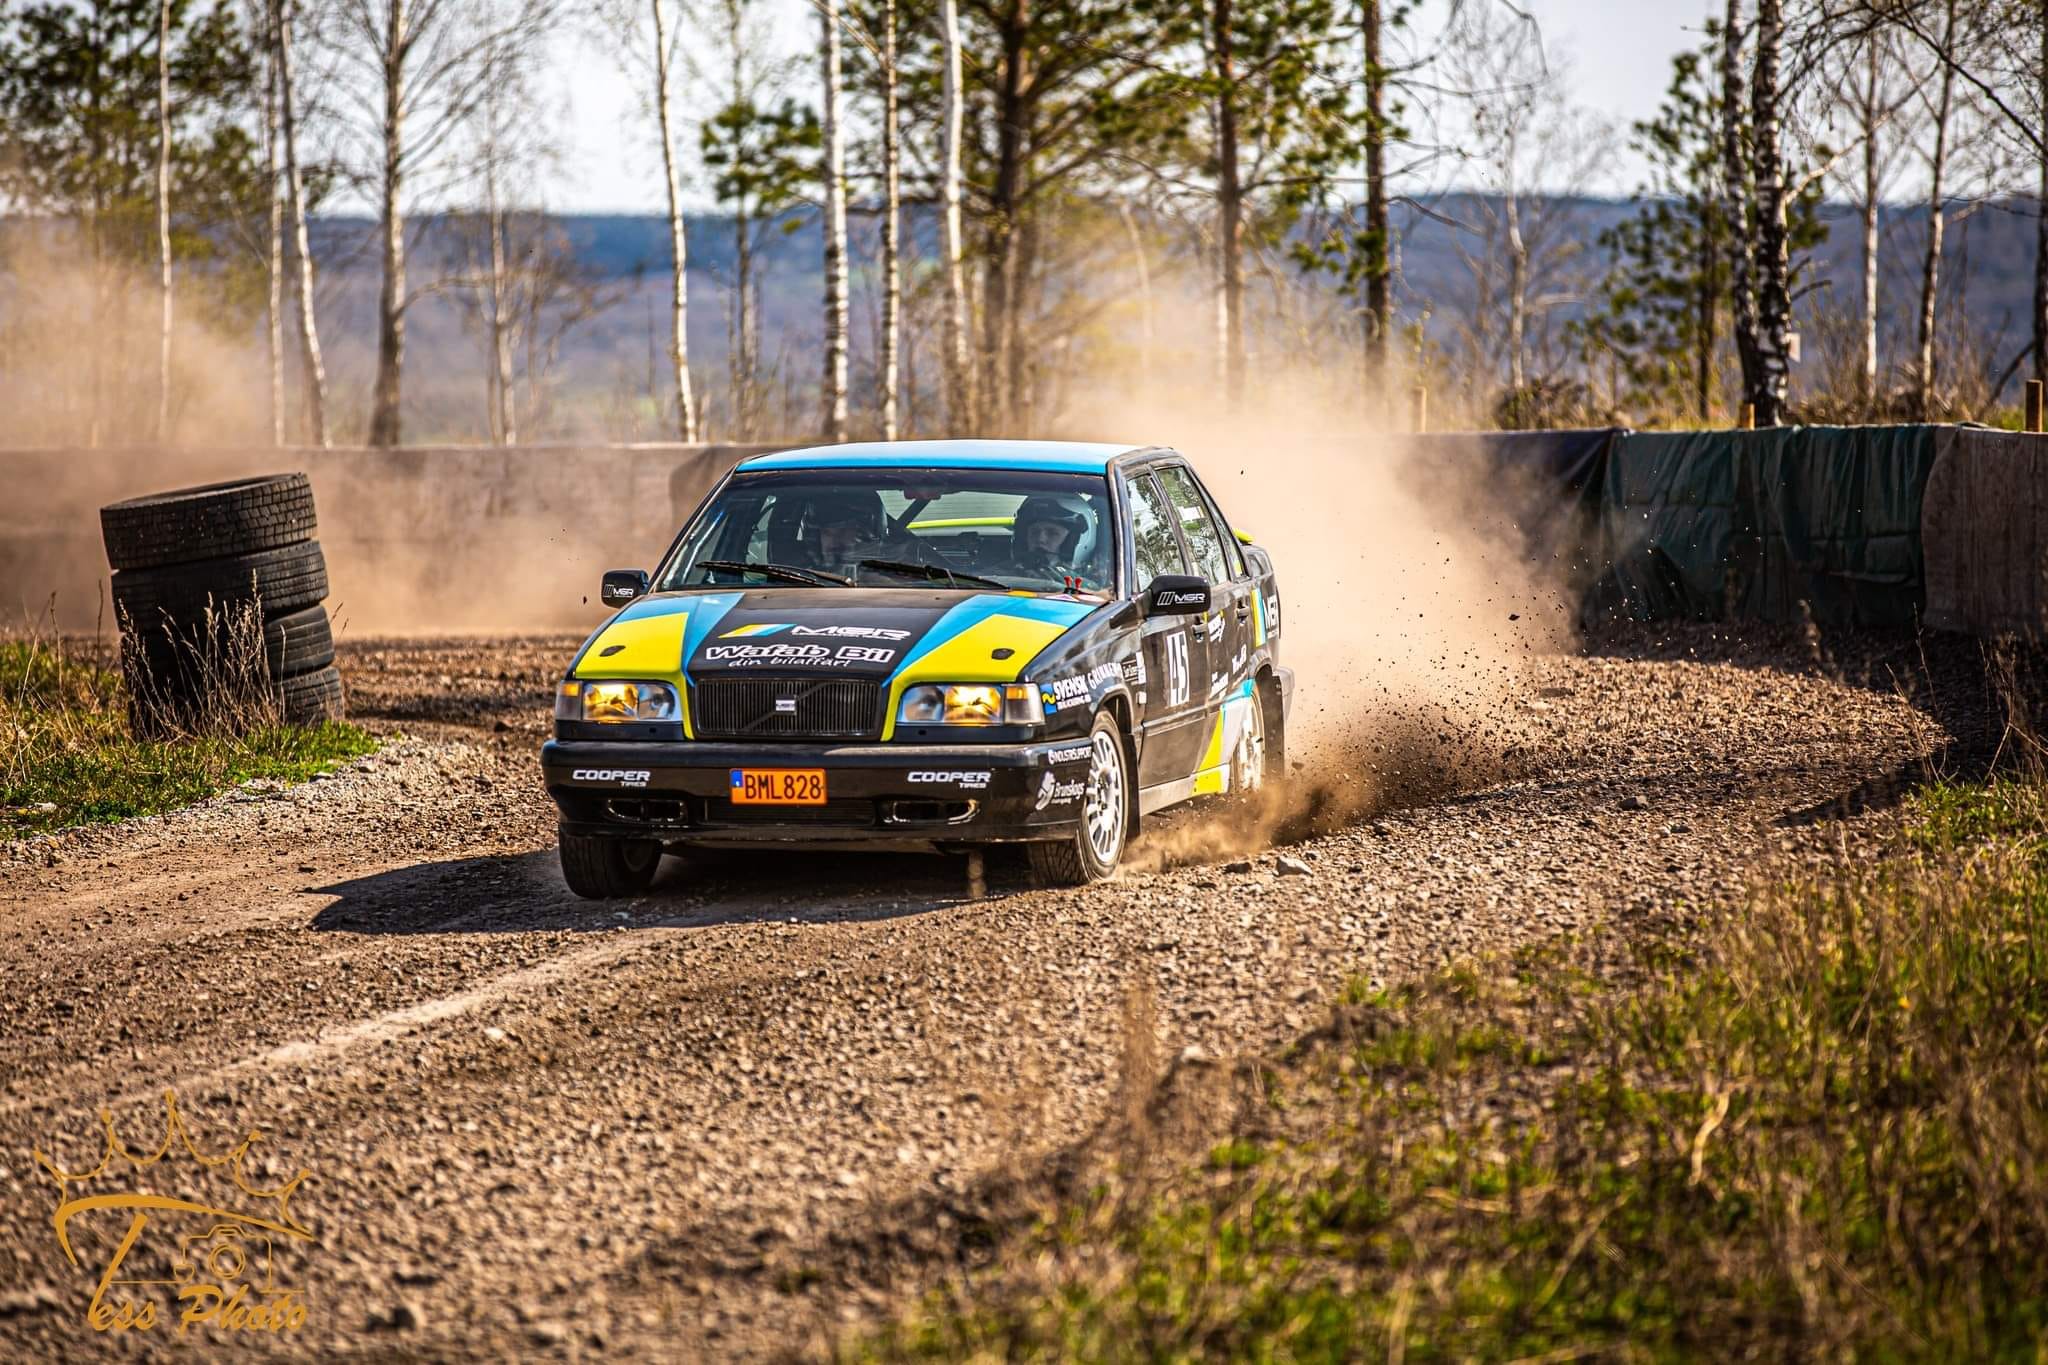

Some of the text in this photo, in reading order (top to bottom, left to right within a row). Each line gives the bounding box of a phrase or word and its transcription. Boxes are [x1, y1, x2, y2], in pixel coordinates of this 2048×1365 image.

[706, 644, 896, 663] Wafab Bil
[728, 657, 762, 668] din
[1053, 674, 1089, 701] SVENSK
[572, 769, 651, 781] COOPER
[907, 771, 991, 782] COOPER
[744, 774, 821, 800] BML828
